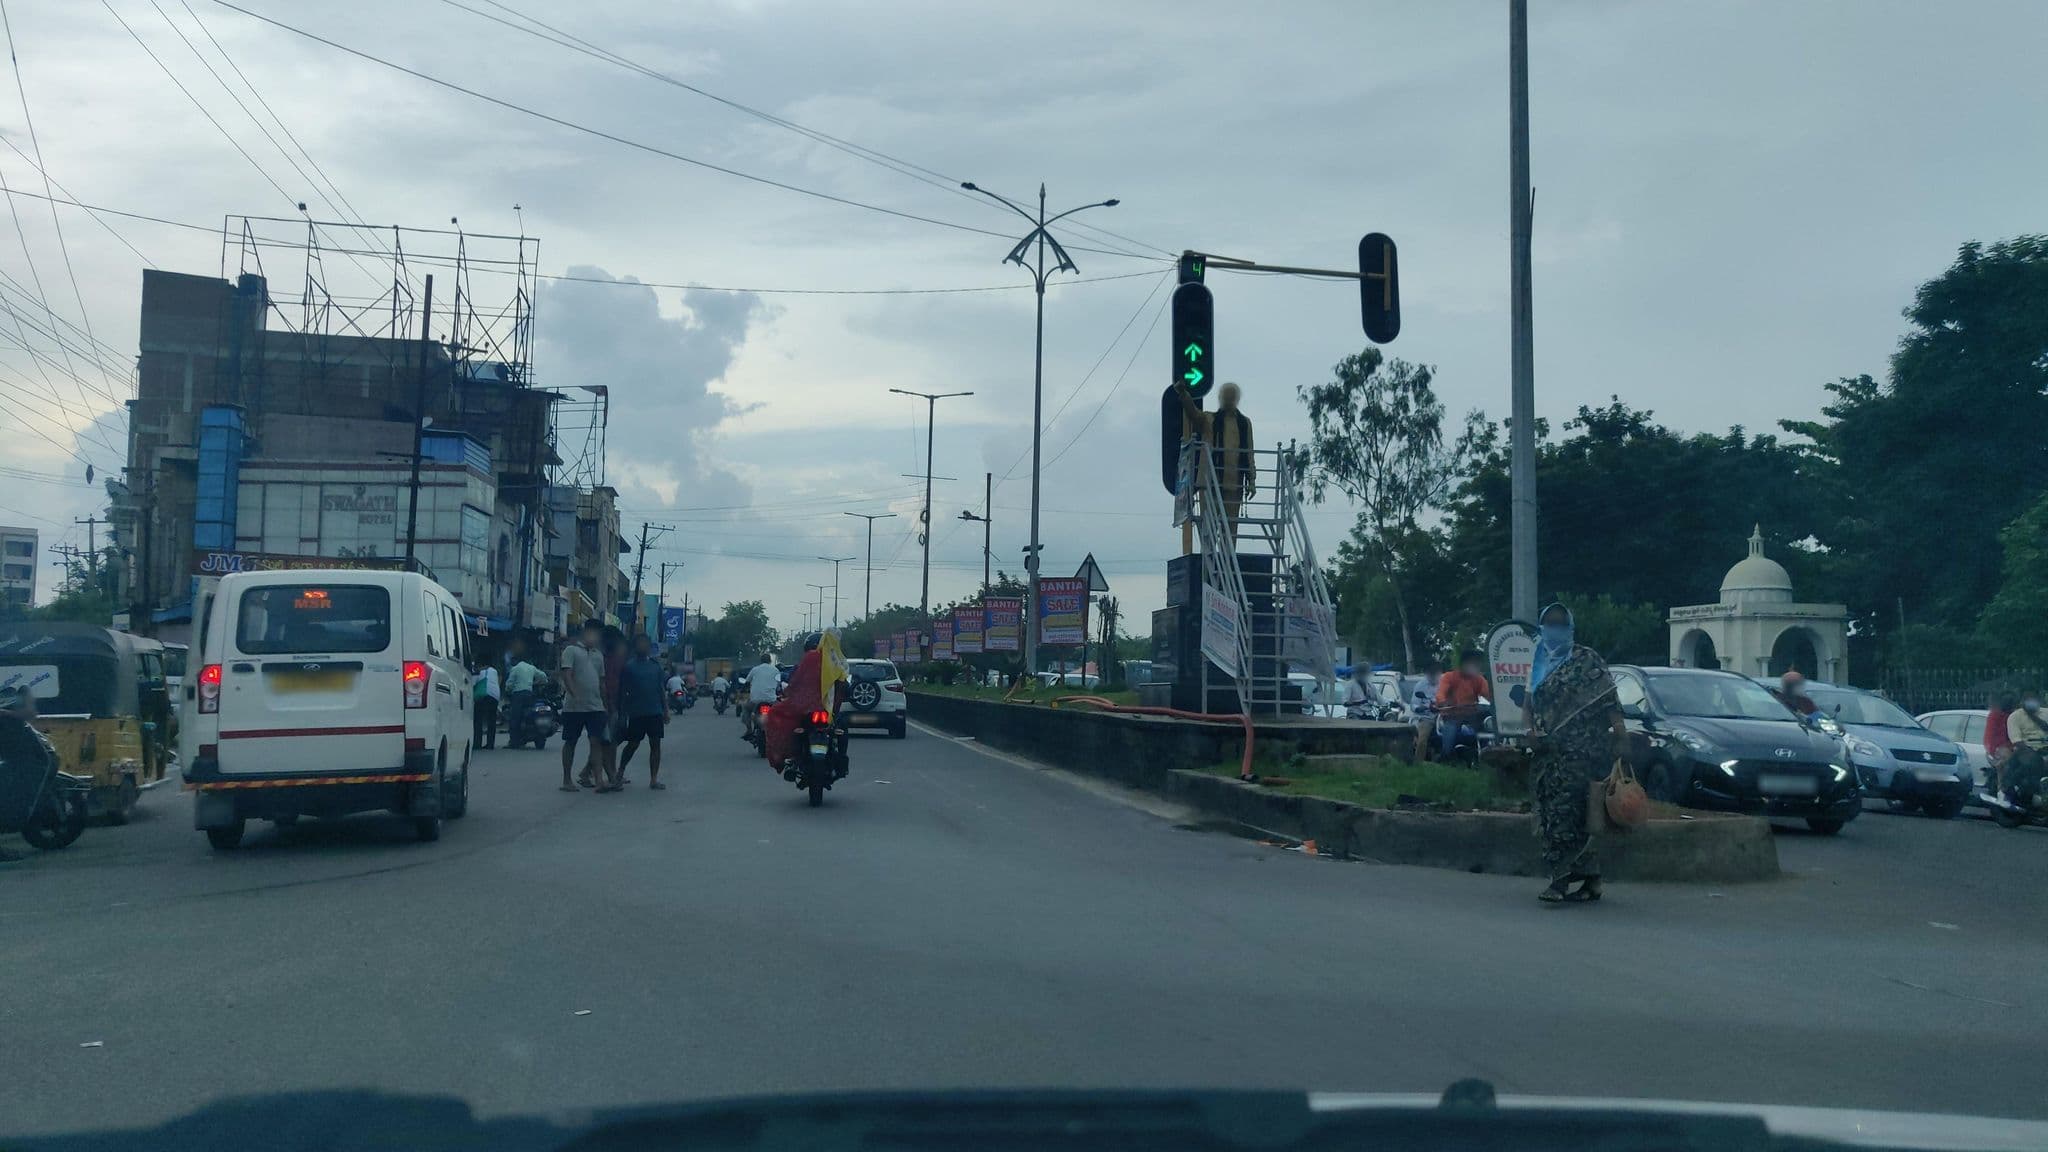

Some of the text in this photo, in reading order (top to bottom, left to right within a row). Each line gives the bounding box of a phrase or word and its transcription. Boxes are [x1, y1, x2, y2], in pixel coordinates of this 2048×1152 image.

[1192, 262, 1202, 277] 4
[358, 514, 393, 525] HOTEL
[1040, 581, 1083, 592] BANTIA
